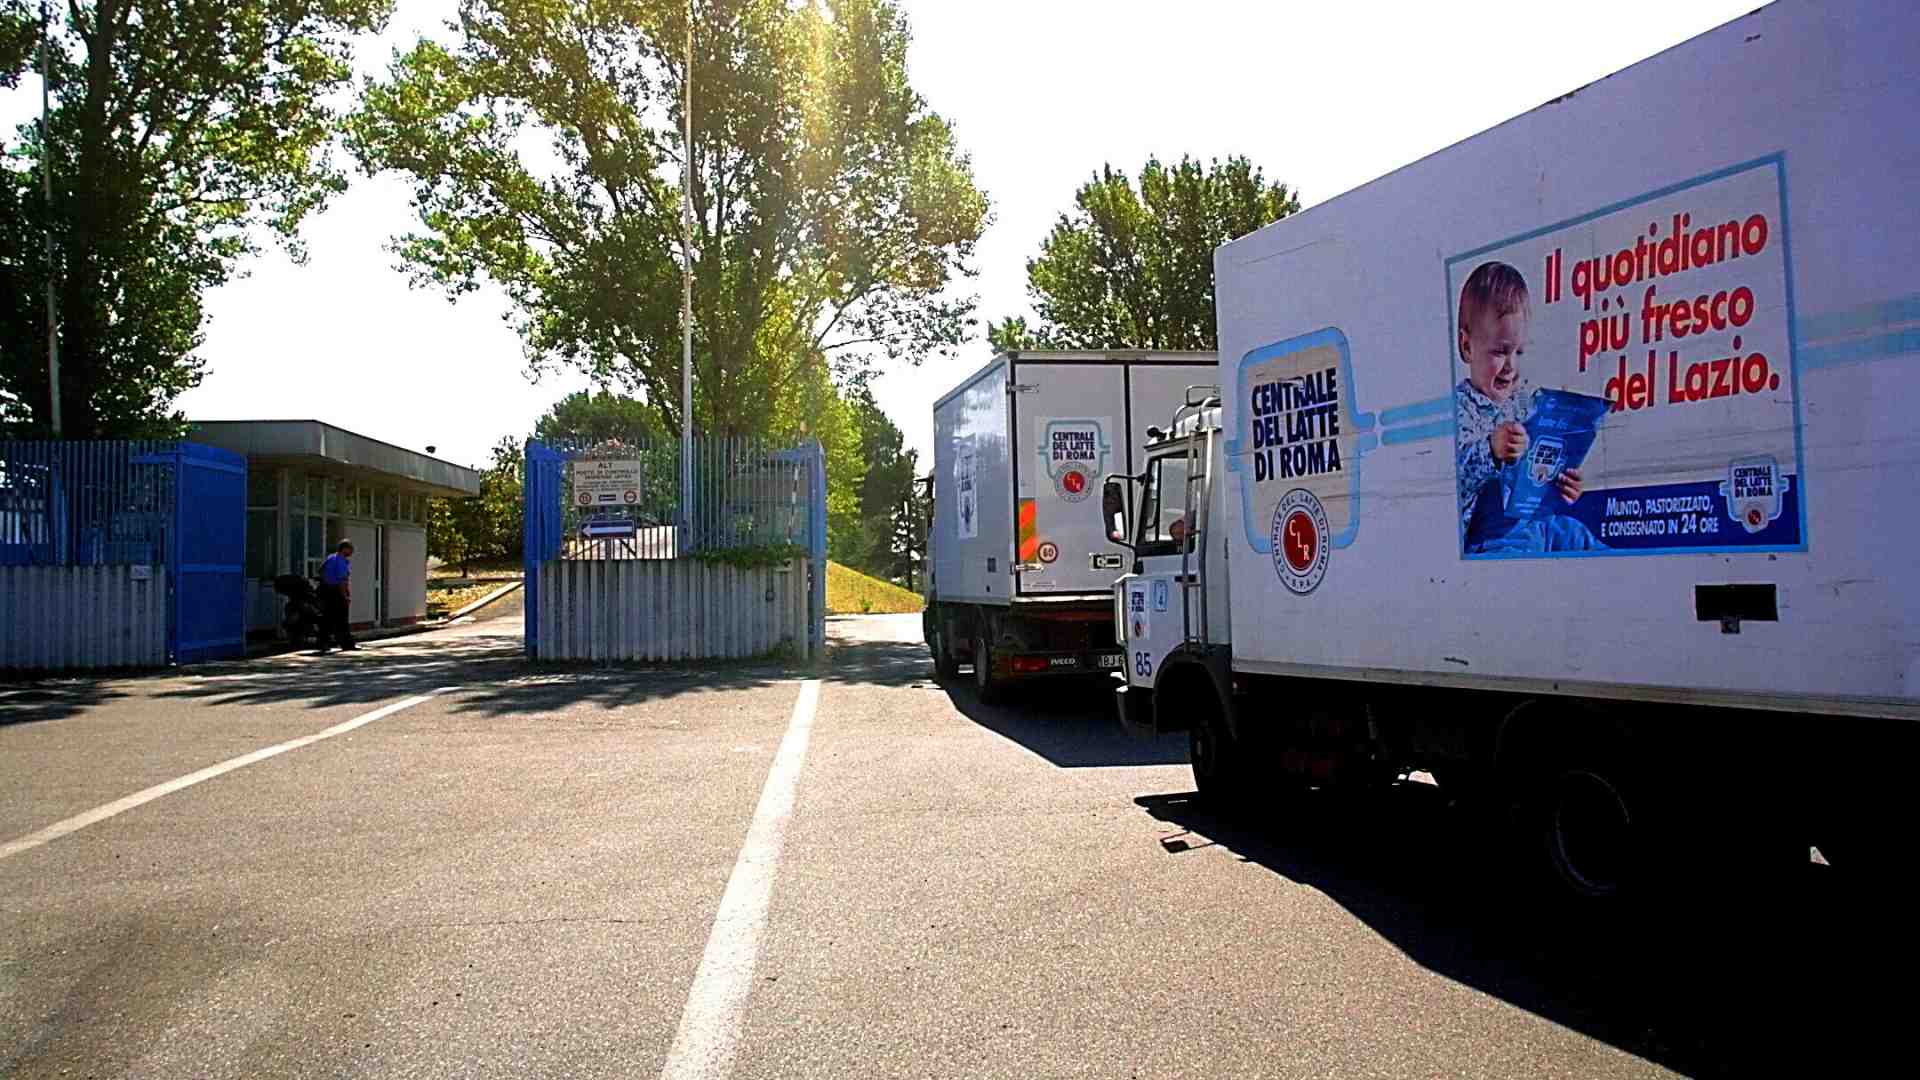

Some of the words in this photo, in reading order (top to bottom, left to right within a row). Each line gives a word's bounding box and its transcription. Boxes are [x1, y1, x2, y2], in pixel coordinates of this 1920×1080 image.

[1545, 248, 1562, 304] Il
[1572, 212, 1768, 311] quotidiano
[1579, 296, 1630, 373] più
[1642, 285, 1754, 344] fresco
[1605, 350, 1655, 413] del
[1668, 336, 1780, 404] Lazio.
[1251, 367, 1338, 417] CENTRALE
[1052, 431, 1096, 441] CENTRALE
[1252, 415, 1284, 449] DEL
[1286, 402, 1340, 443] LATTE
[1052, 441, 1068, 450] DEL
[1070, 441, 1096, 451] LATTE
[1052, 451, 1064, 460] DI
[1066, 451, 1096, 460] ROMA
[1254, 449, 1274, 482] DI
[1280, 439, 1342, 479] ROMA
[1734, 464, 1772, 478] CENTRALE
[1734, 478, 1748, 488] DEL
[1750, 476, 1773, 487] LATTE
[1734, 487, 1744, 498] DI
[1746, 486, 1774, 497] ROMA
[1600, 522, 1607, 538] E
[1608, 520, 1666, 537] CONSEGNATO
[1667, 519, 1679, 534] IN
[1681, 513, 1697, 534] 24
[1700, 517, 1719, 534] ORE
[1050, 657, 1076, 665] IVECO
[1136, 651, 1152, 677] 85
